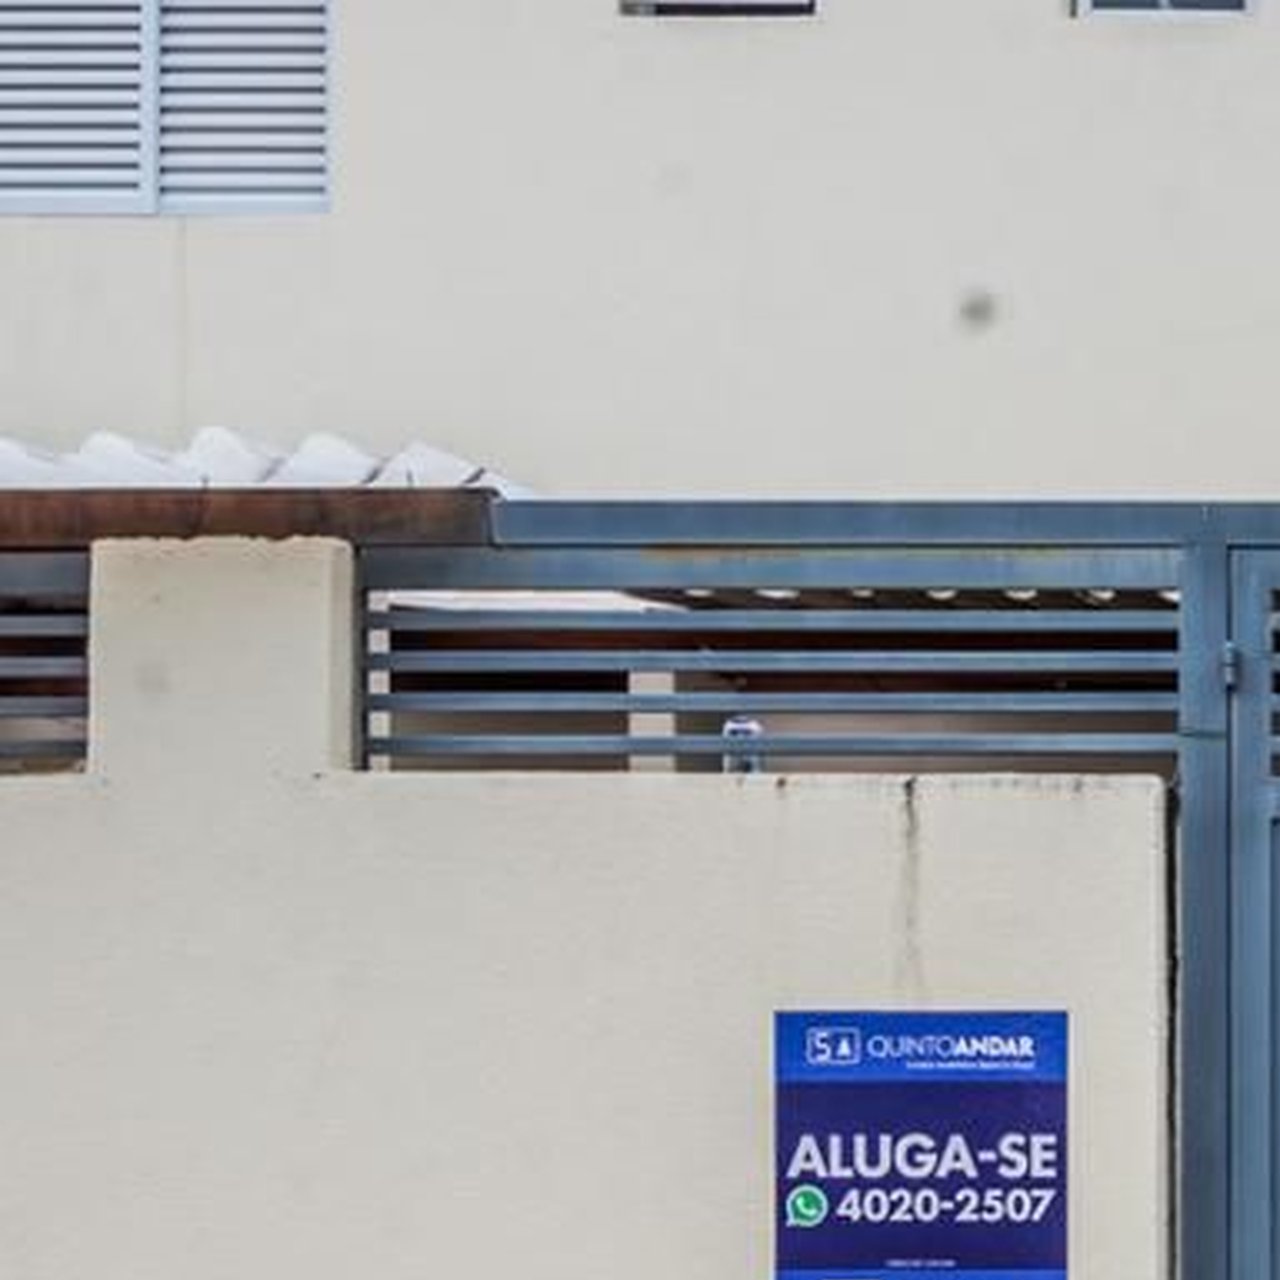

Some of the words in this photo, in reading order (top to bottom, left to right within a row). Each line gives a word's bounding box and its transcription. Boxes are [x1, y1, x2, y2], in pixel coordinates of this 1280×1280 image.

[867, 1035, 1035, 1058] QUINTOANDAR
[786, 1133, 1057, 1179] ALUGA-SE
[836, 1188, 1056, 1222] 4020-2507
